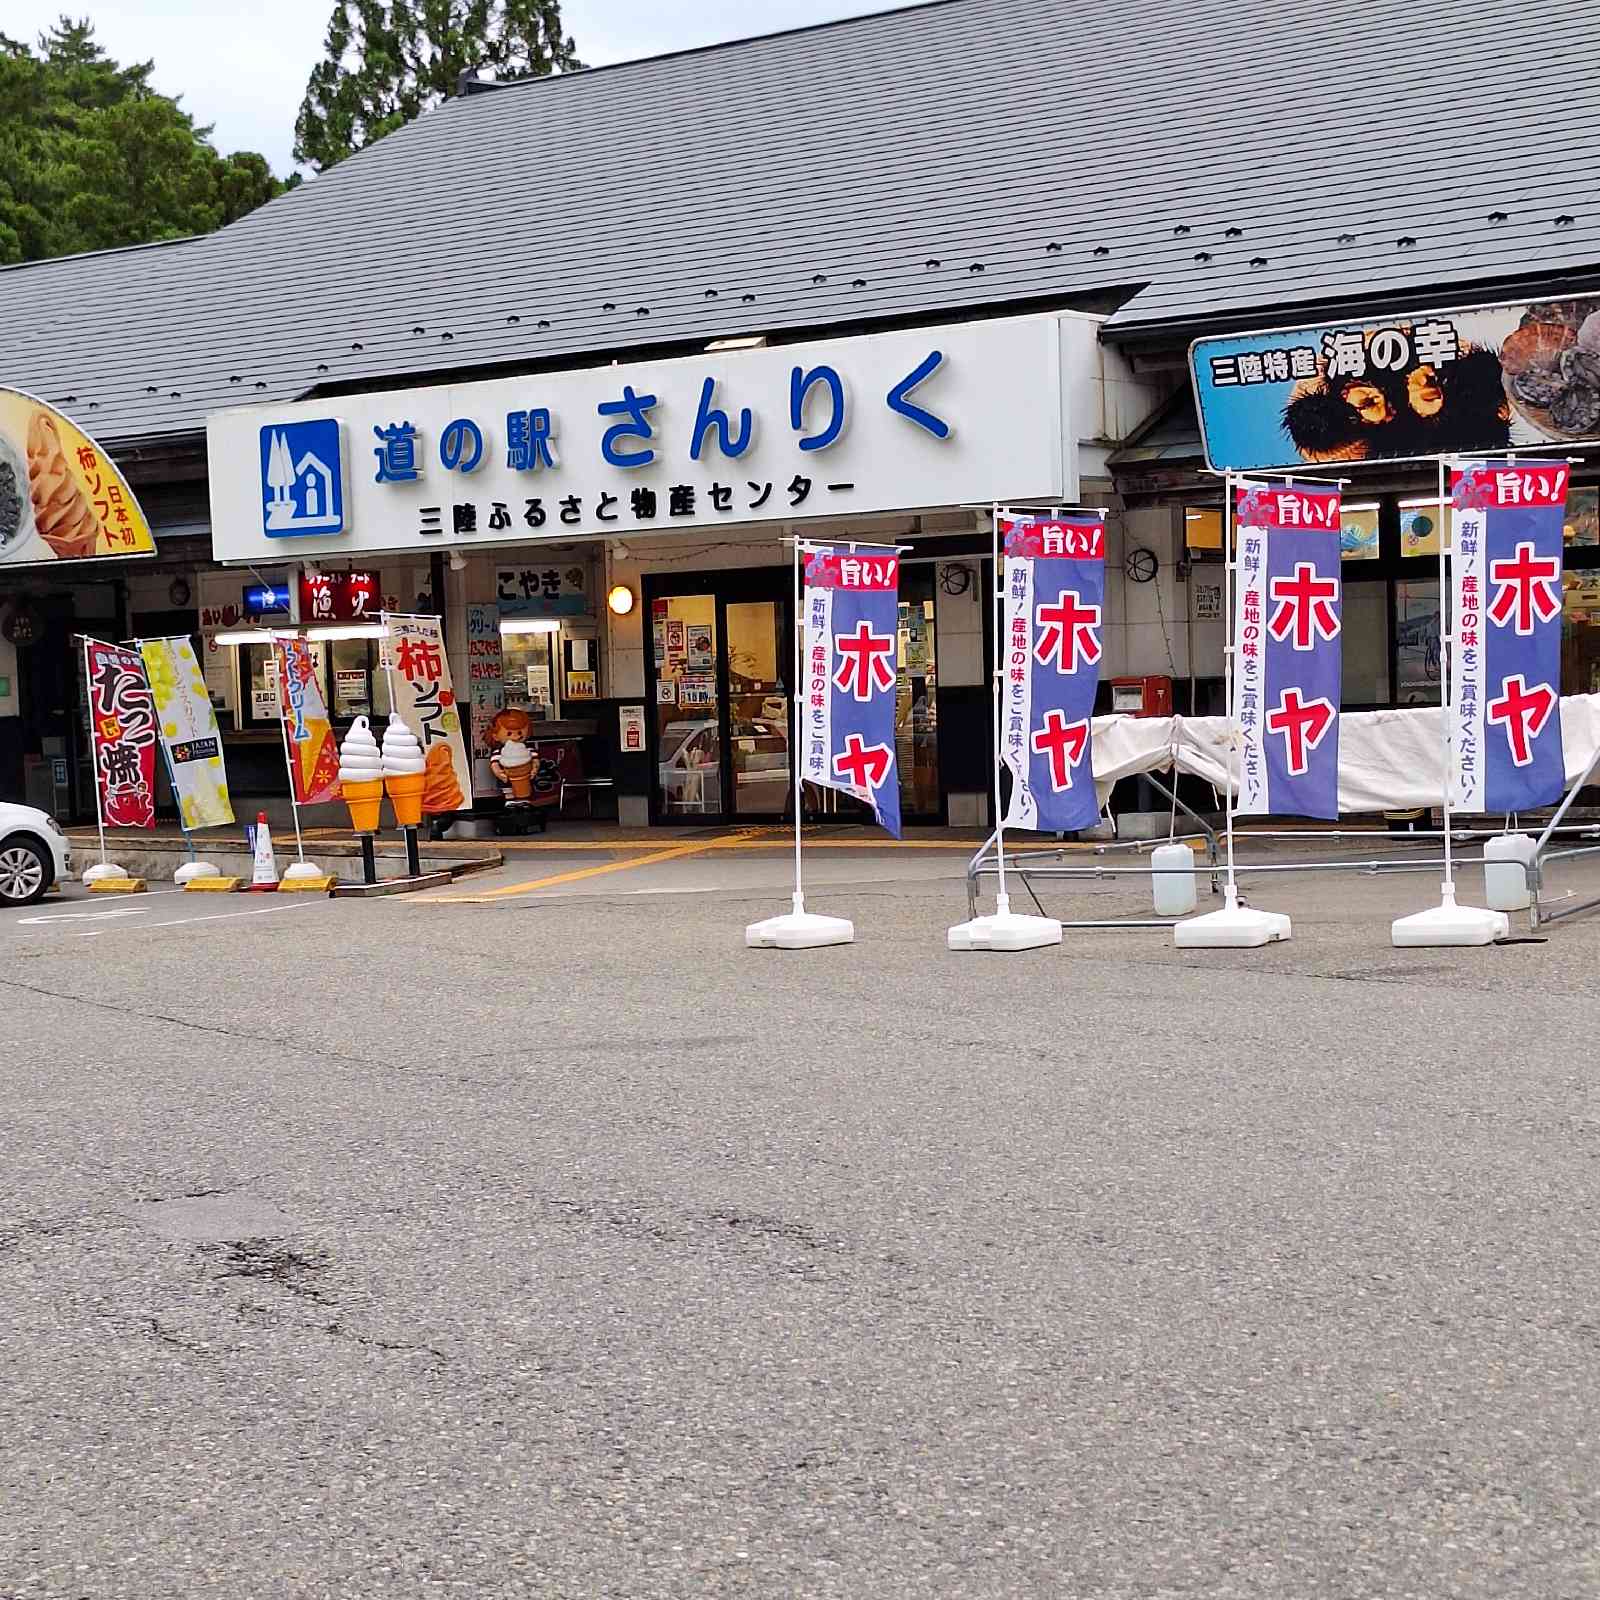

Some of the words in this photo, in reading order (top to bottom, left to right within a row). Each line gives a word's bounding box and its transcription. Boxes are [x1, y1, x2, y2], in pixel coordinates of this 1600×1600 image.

[1211, 347, 1318, 384] 三陸特産
[1321, 318, 1460, 380] 海の幸
[372, 406, 556, 484] 道の駅
[597, 348, 952, 468] さんりく
[76, 446, 118, 548] 柿ソフト
[107, 485, 136, 546] 日本初
[418, 474, 855, 535] 三陸ふるさと物産センター
[1275, 494, 1337, 526] 旨い!
[1496, 472, 1565, 505] 旨い!
[839, 558, 896, 587] 旨い!
[1041, 525, 1102, 555] 旨い!
[396, 637, 448, 745] 柿ソフト
[831, 620, 897, 791] ホヤ
[1031, 590, 1102, 793] ホヤ
[1264, 561, 1341, 776] ホヤ
[1459, 520, 1479, 804] 新鮮!産地の味をご賞味ください!
[1488, 541, 1562, 768] ホヤ
